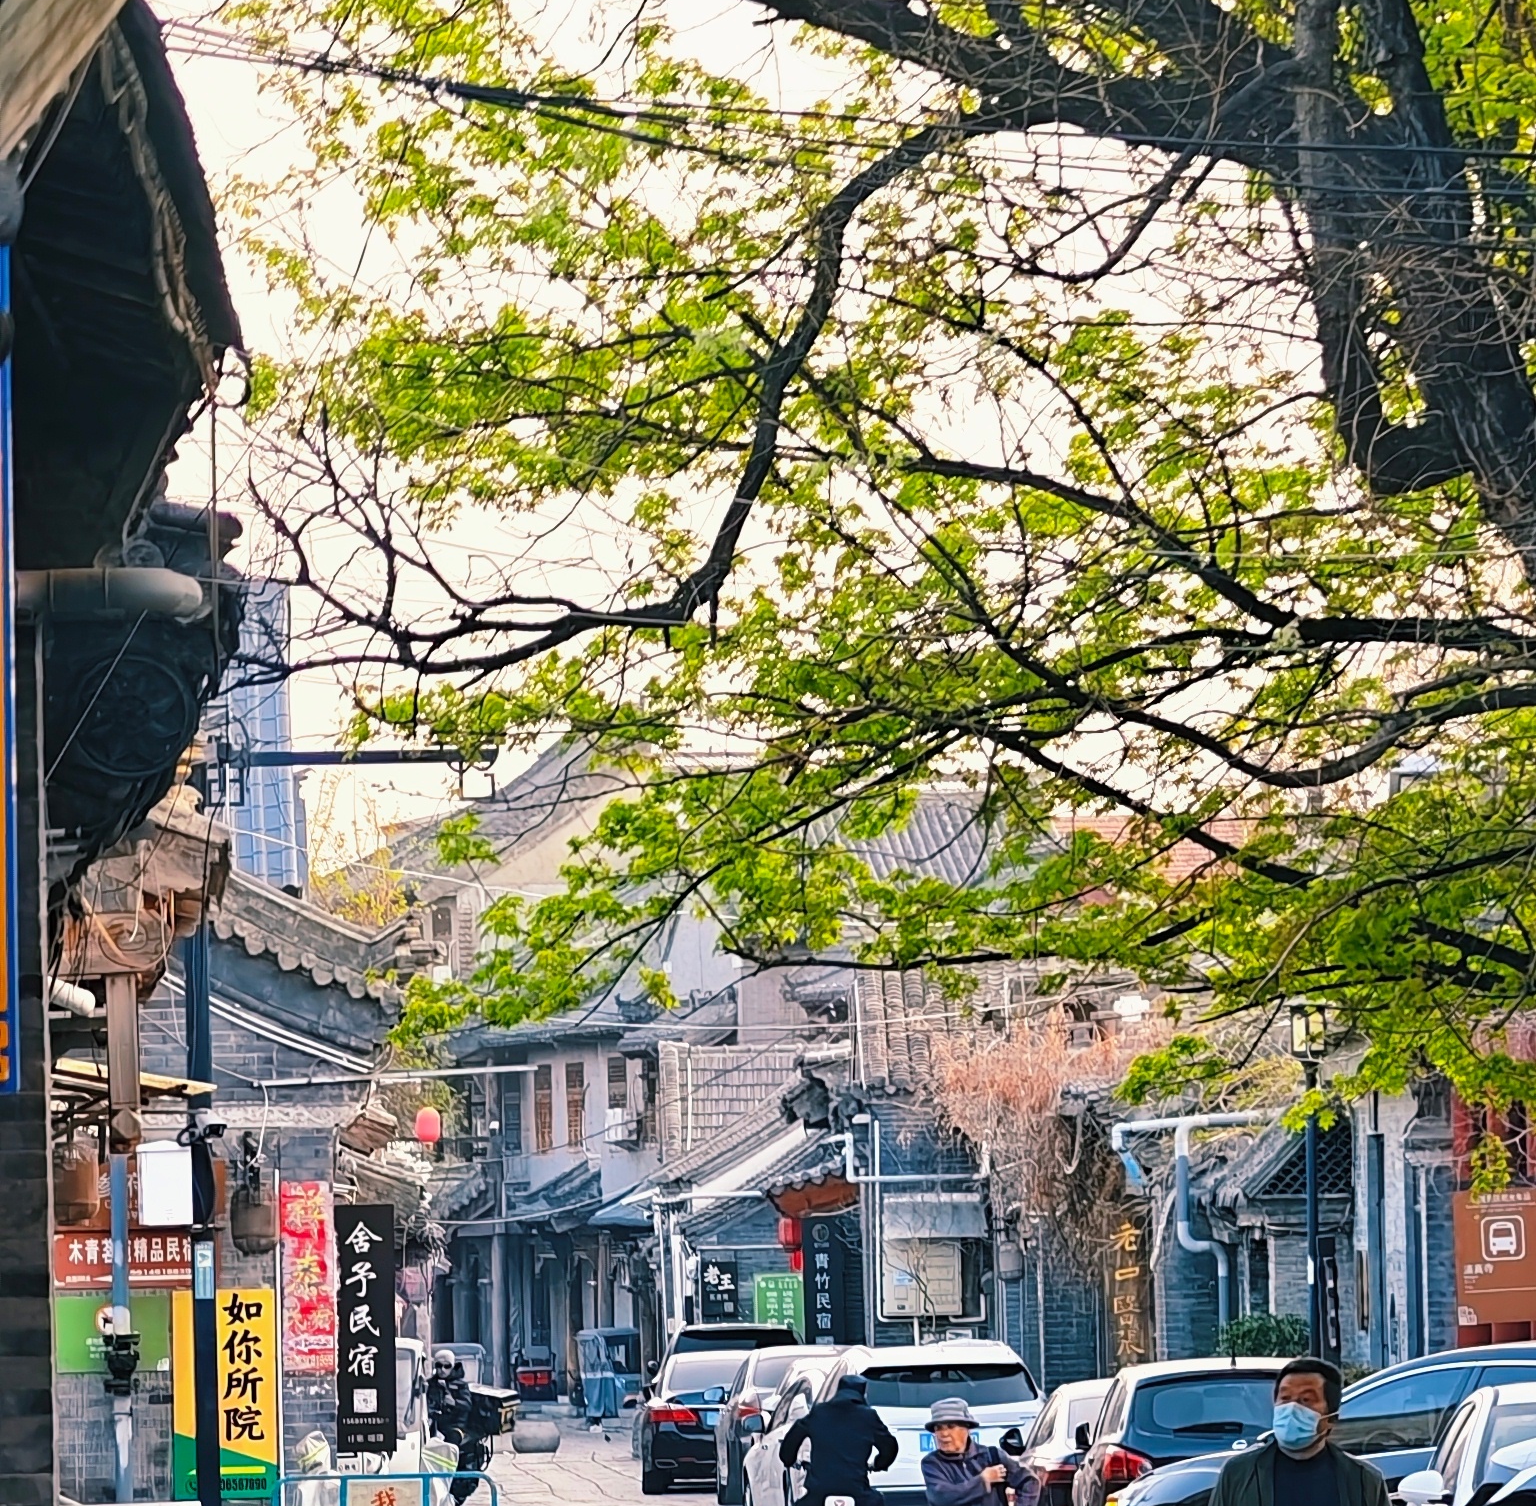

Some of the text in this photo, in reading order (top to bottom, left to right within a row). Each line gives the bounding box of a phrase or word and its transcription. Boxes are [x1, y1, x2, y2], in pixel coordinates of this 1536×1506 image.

[345, 1221, 383, 1377] 舍予民宿
[704, 1264, 735, 1290] 老王
[815, 1253, 831, 1329] 青竹民宿
[222, 1293, 264, 1441] 如你所院
